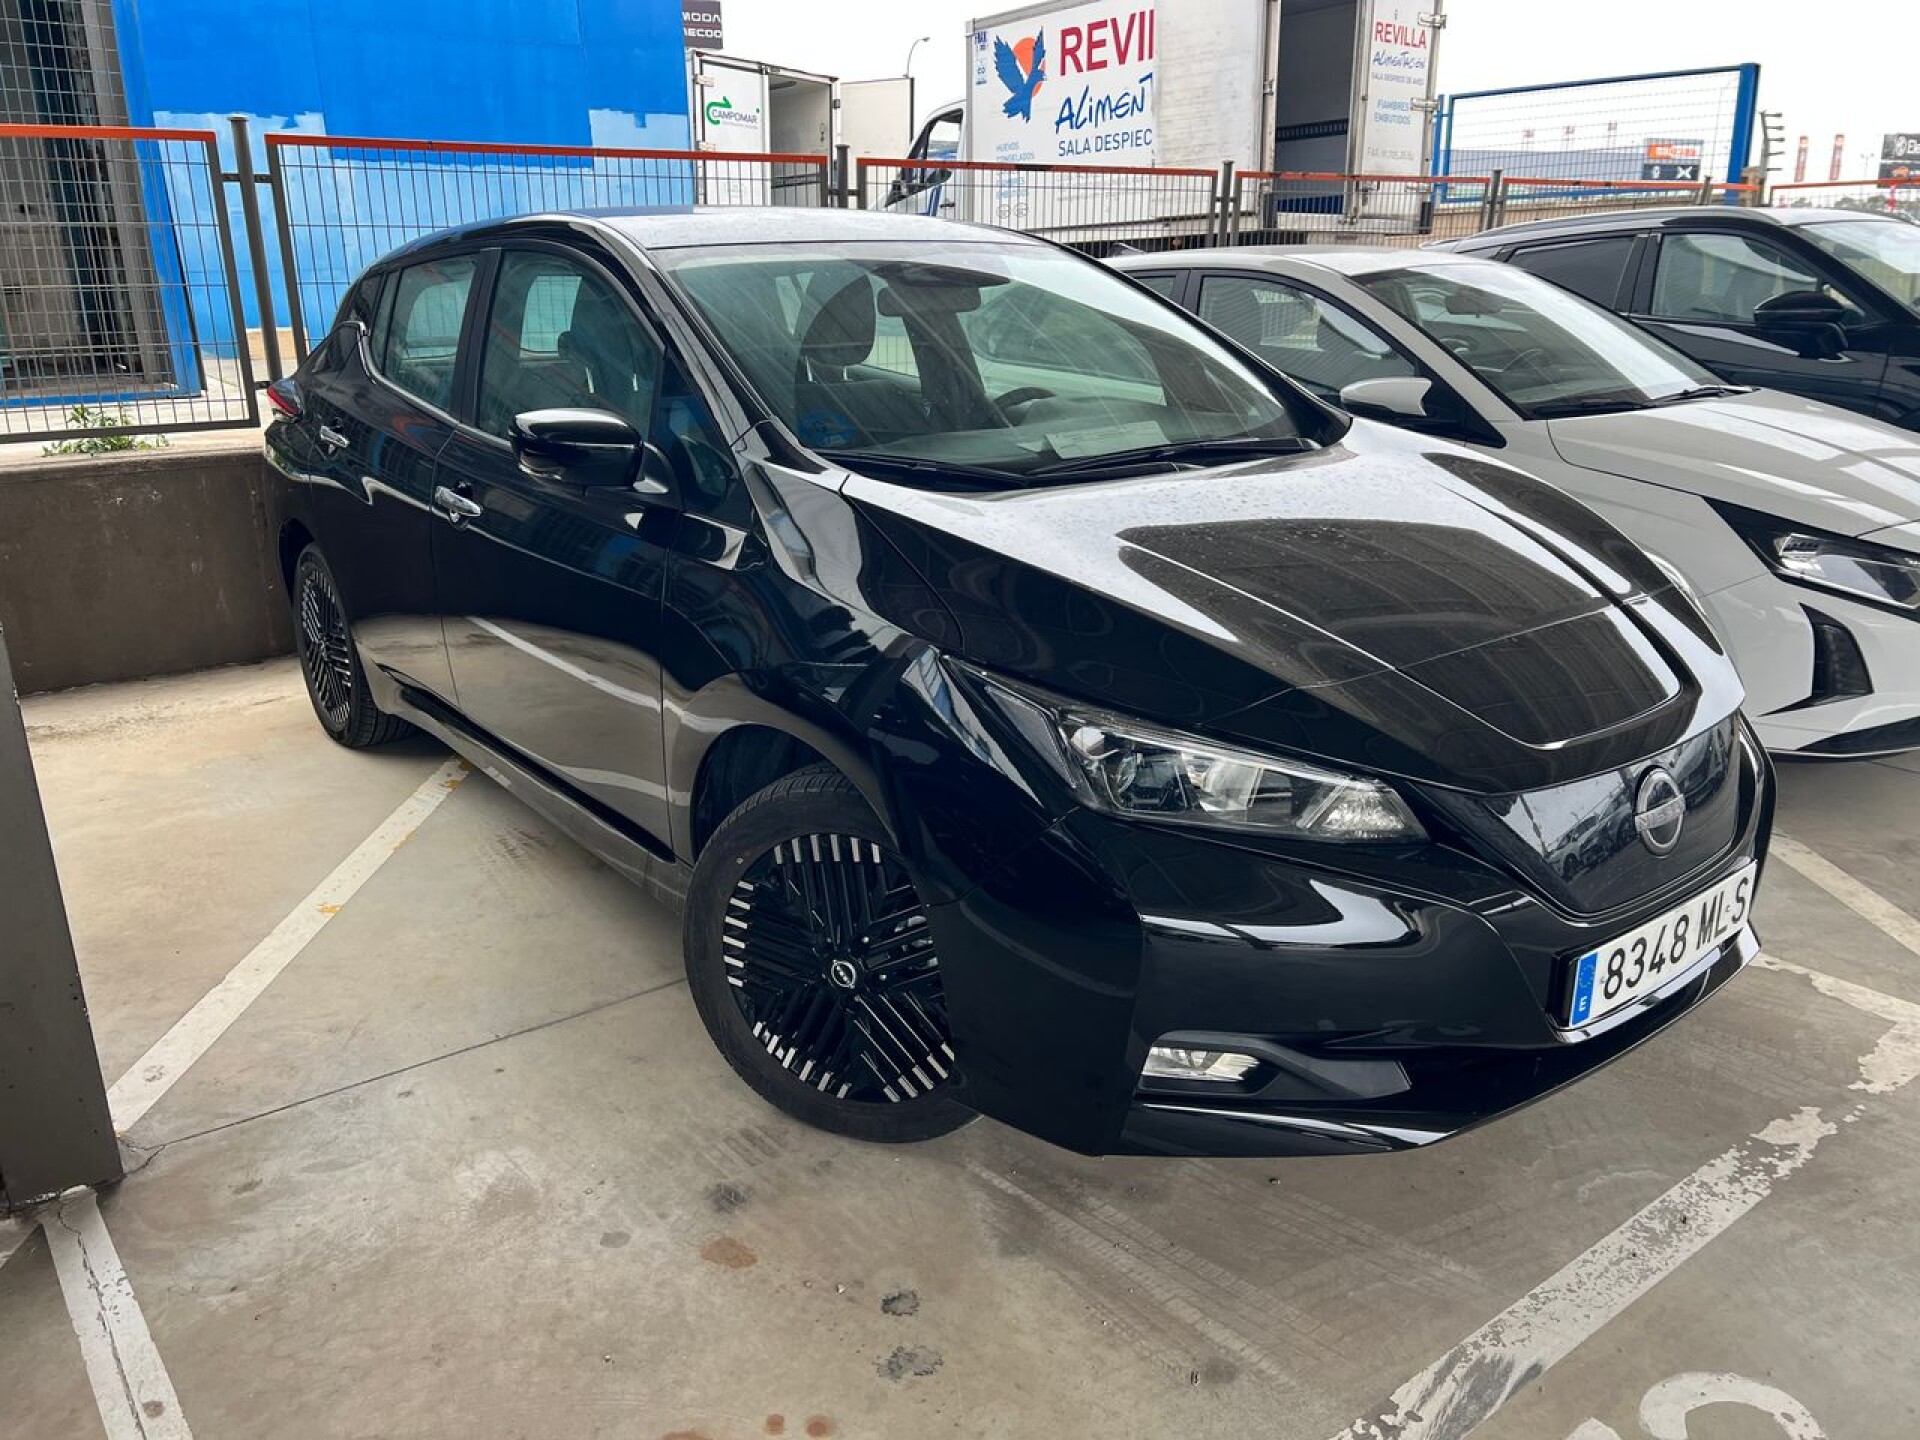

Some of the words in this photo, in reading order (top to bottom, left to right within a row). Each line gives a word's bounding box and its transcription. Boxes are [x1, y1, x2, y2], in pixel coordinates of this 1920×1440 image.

[1375, 22, 1426, 48] REVILLA
[712, 109, 758, 123] CAMPOMAR
[1058, 138, 1091, 156] SALA
[1095, 129, 1152, 153] DESPIEC
[1603, 915, 1690, 999] 8348
[1697, 877, 1749, 951] MLS
[1579, 996, 1588, 1011] E
